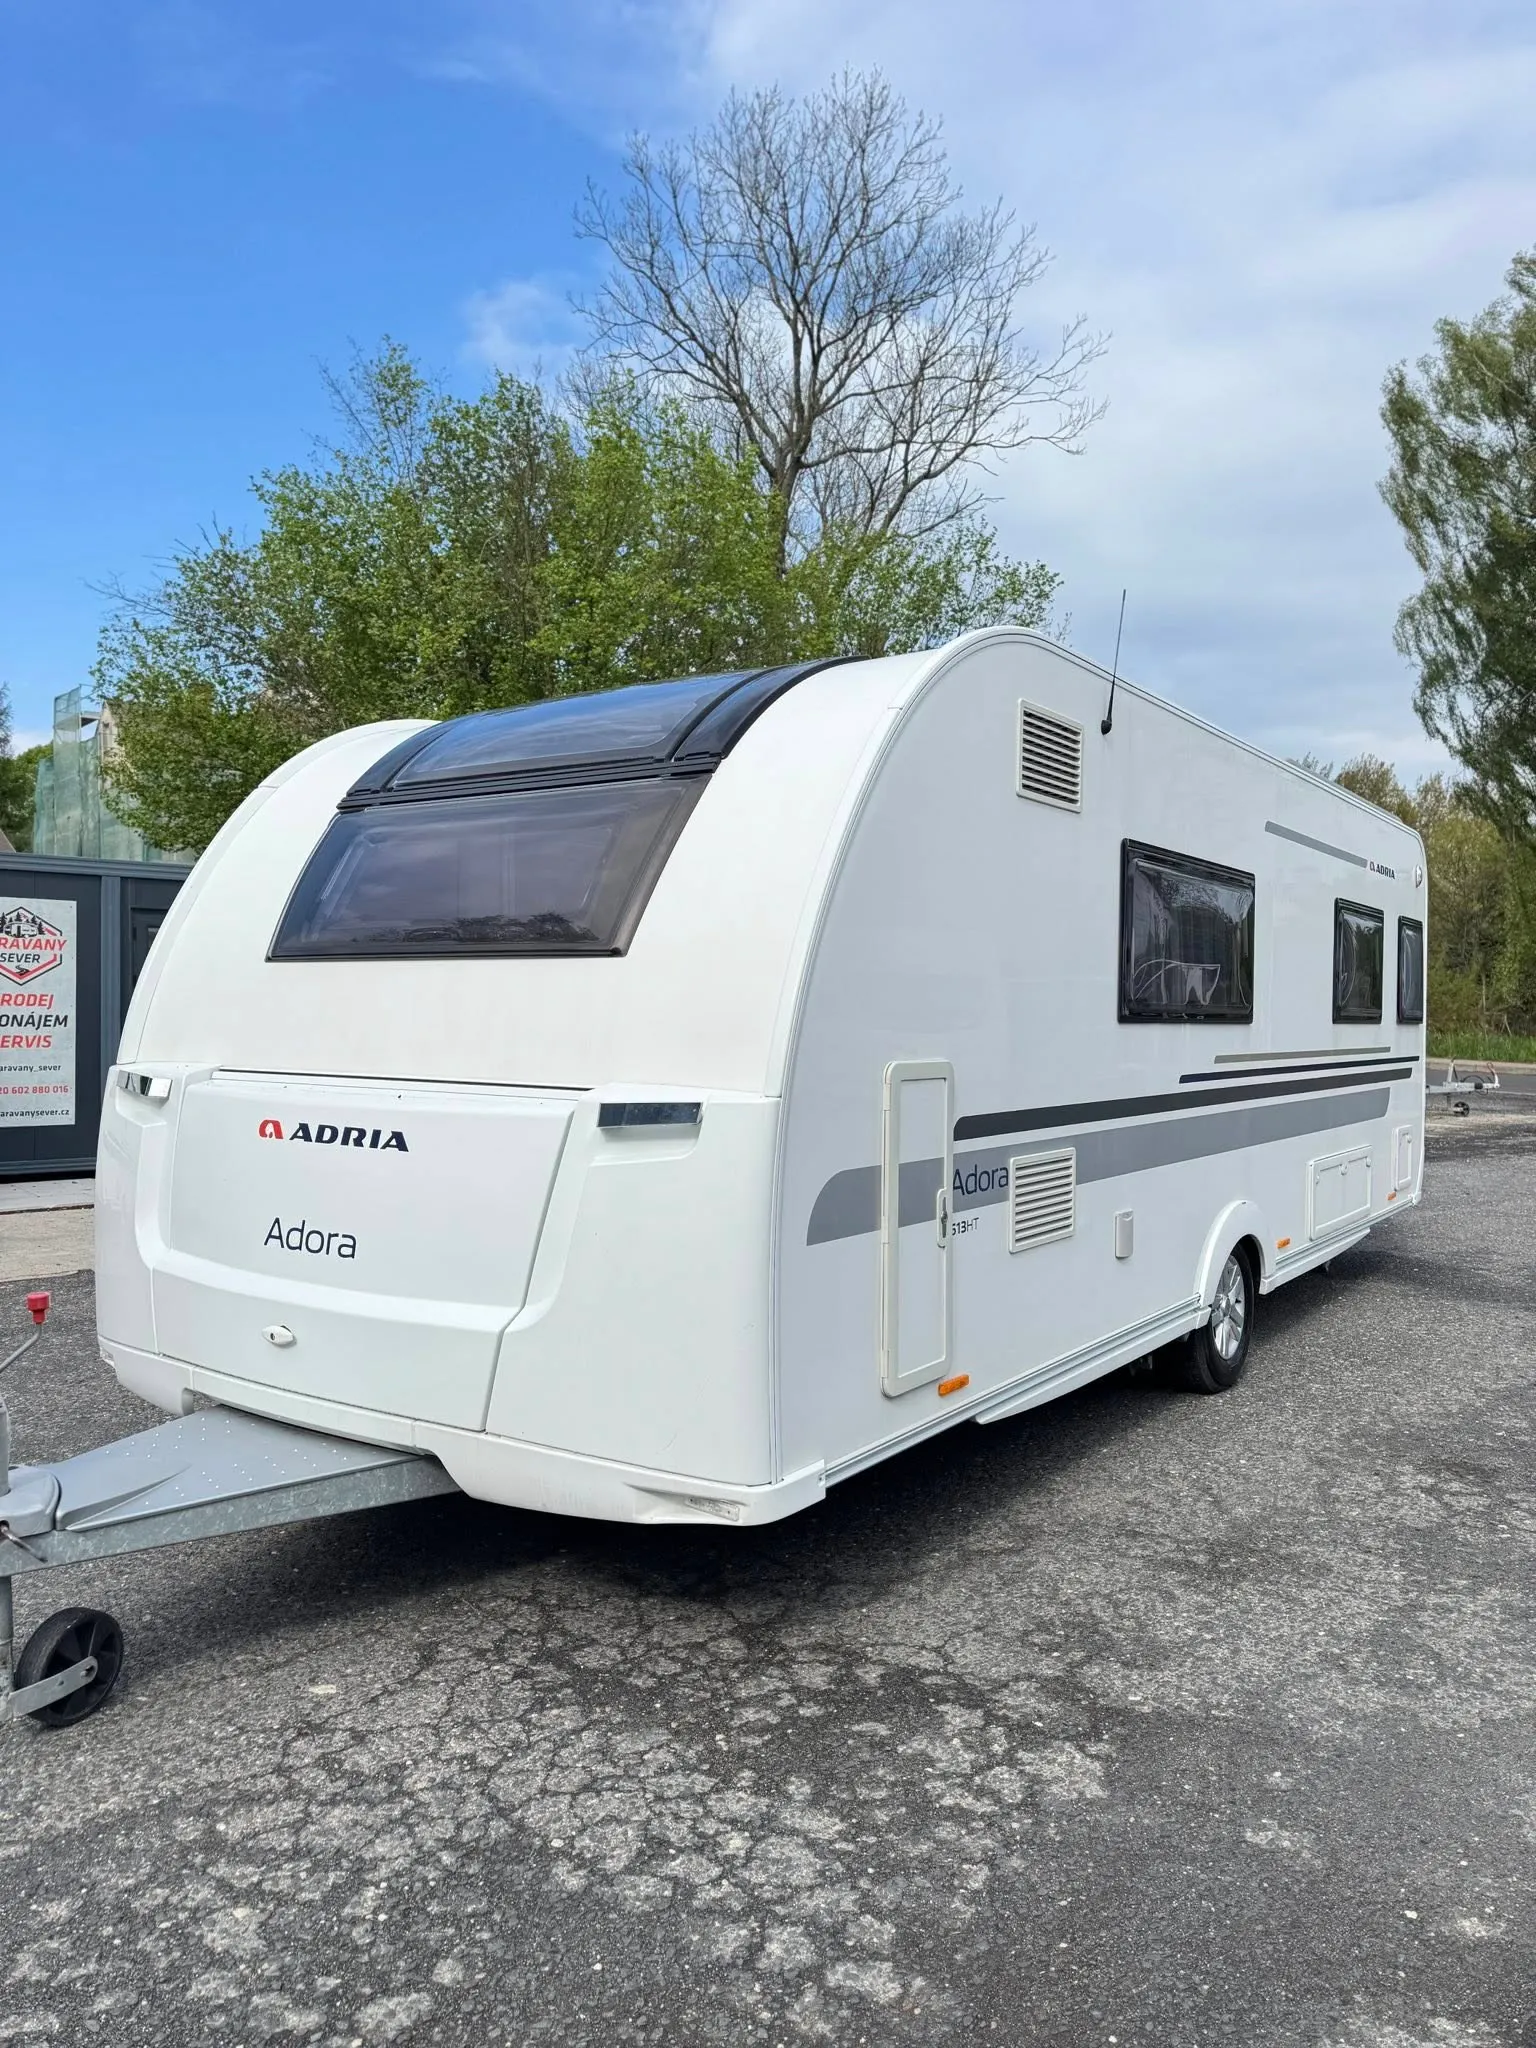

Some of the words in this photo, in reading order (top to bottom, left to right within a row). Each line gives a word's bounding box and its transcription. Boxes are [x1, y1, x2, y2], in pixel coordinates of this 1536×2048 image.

[0, 953, 41, 964] SEVER
[0, 993, 54, 1010] RODEJ
[0, 1011, 69, 1031] ONÁJEM
[0, 1035, 53, 1049] ERVIS
[11, 1086, 30, 1095] 602
[32, 1085, 50, 1094] 880
[52, 1085, 69, 1094] 016
[289, 1122, 410, 1153] ADRIA
[953, 1163, 1009, 1196] Adora
[263, 1216, 357, 1259] Adora
